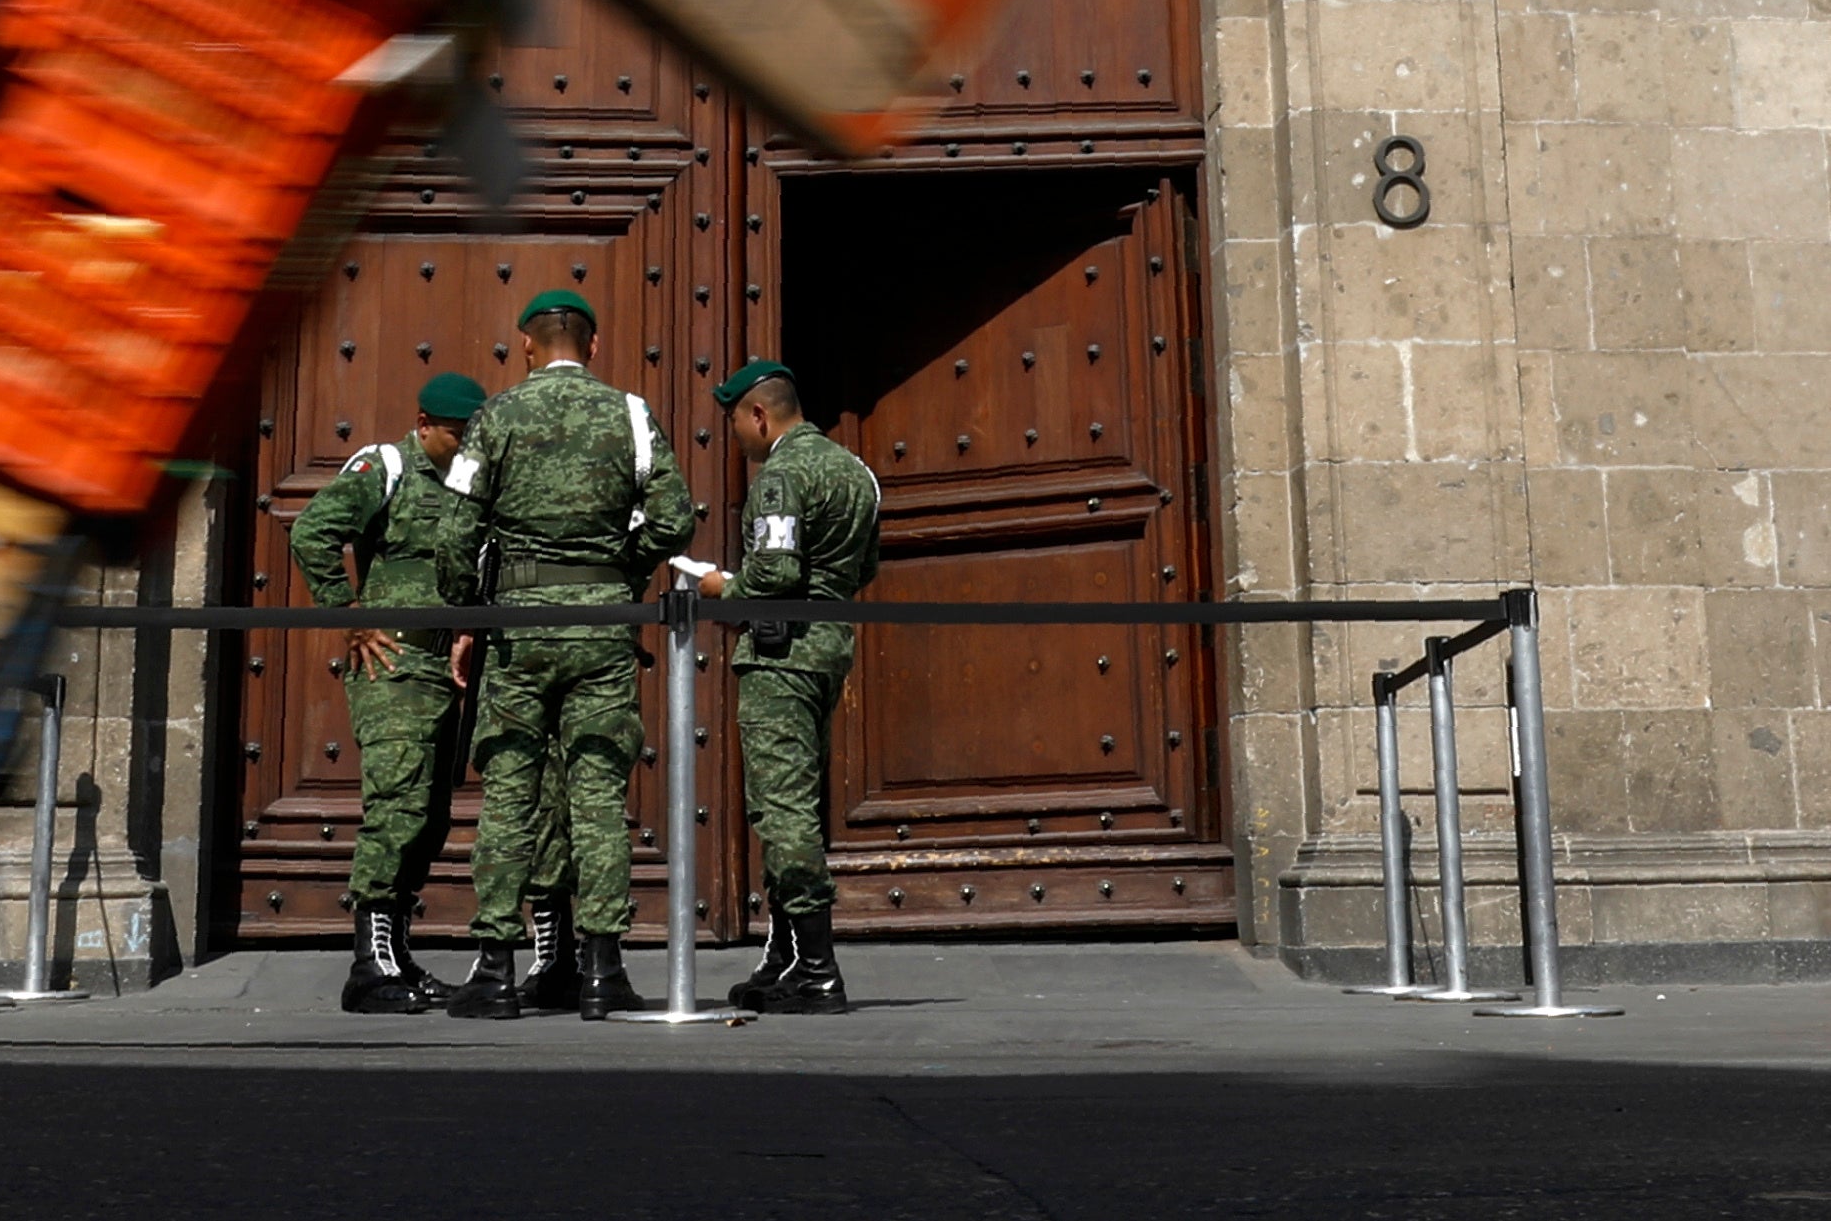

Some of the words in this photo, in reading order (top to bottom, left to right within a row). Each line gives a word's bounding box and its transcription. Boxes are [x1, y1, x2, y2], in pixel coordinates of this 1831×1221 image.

[1372, 135, 1430, 229] 8
[444, 454, 480, 495] M
[753, 515, 796, 552] PM
